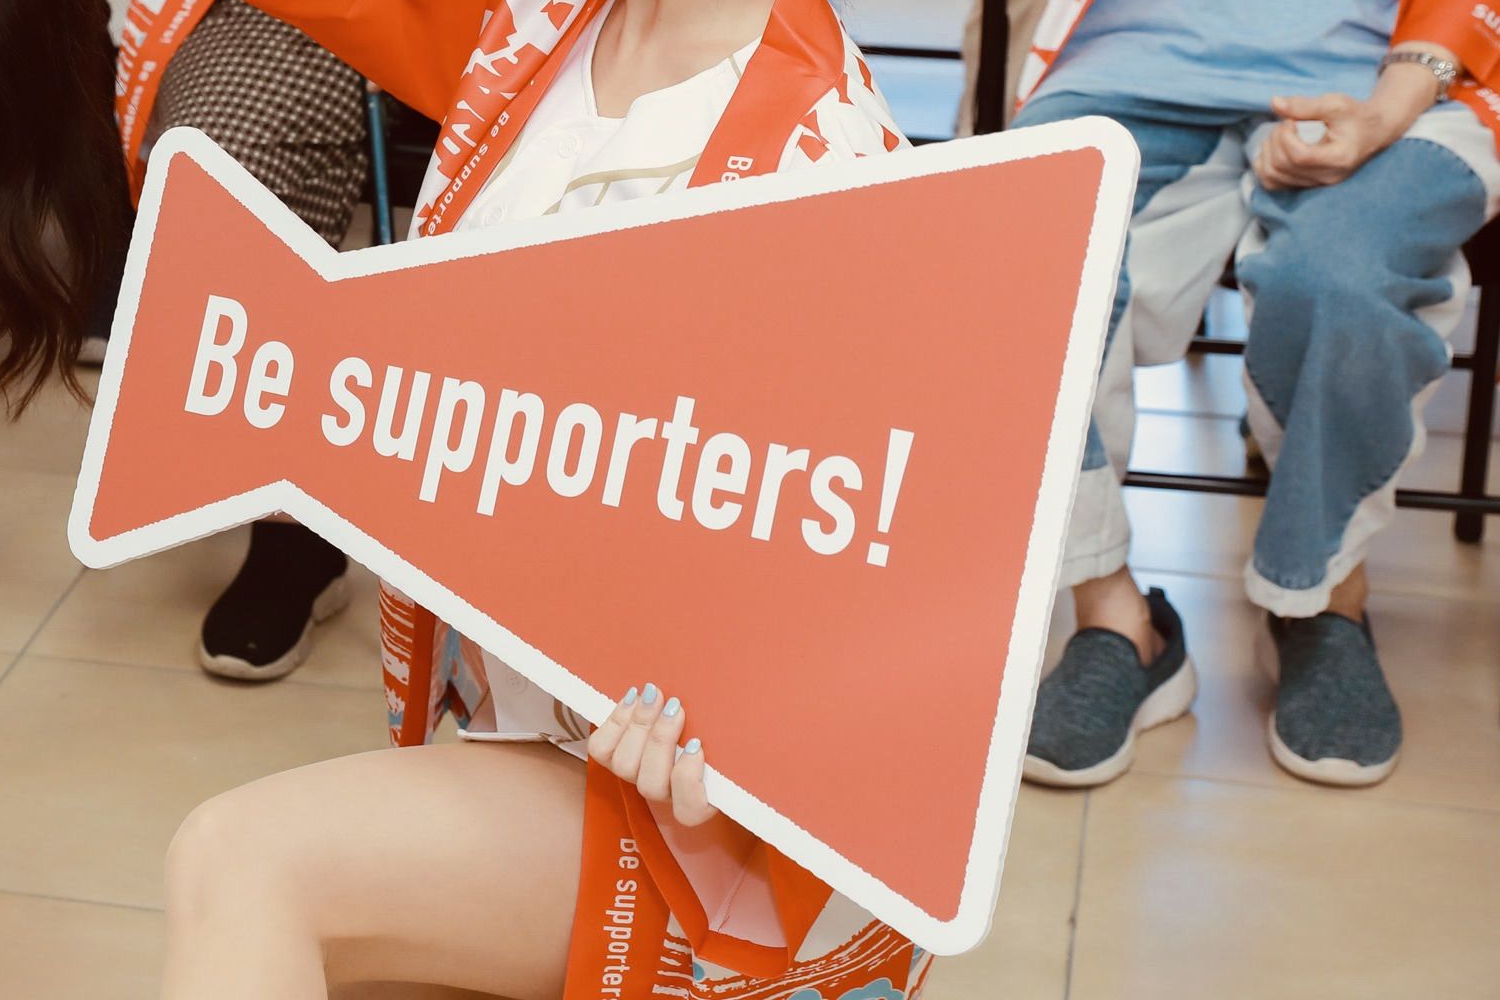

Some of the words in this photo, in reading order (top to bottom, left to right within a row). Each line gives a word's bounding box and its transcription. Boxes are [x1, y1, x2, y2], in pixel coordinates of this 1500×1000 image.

[490, 110, 510, 138] Be
[426, 143, 489, 237] supporte
[183, 293, 296, 430] Be
[319, 354, 916, 568] supporters!
[600, 878, 638, 1000] supporter
